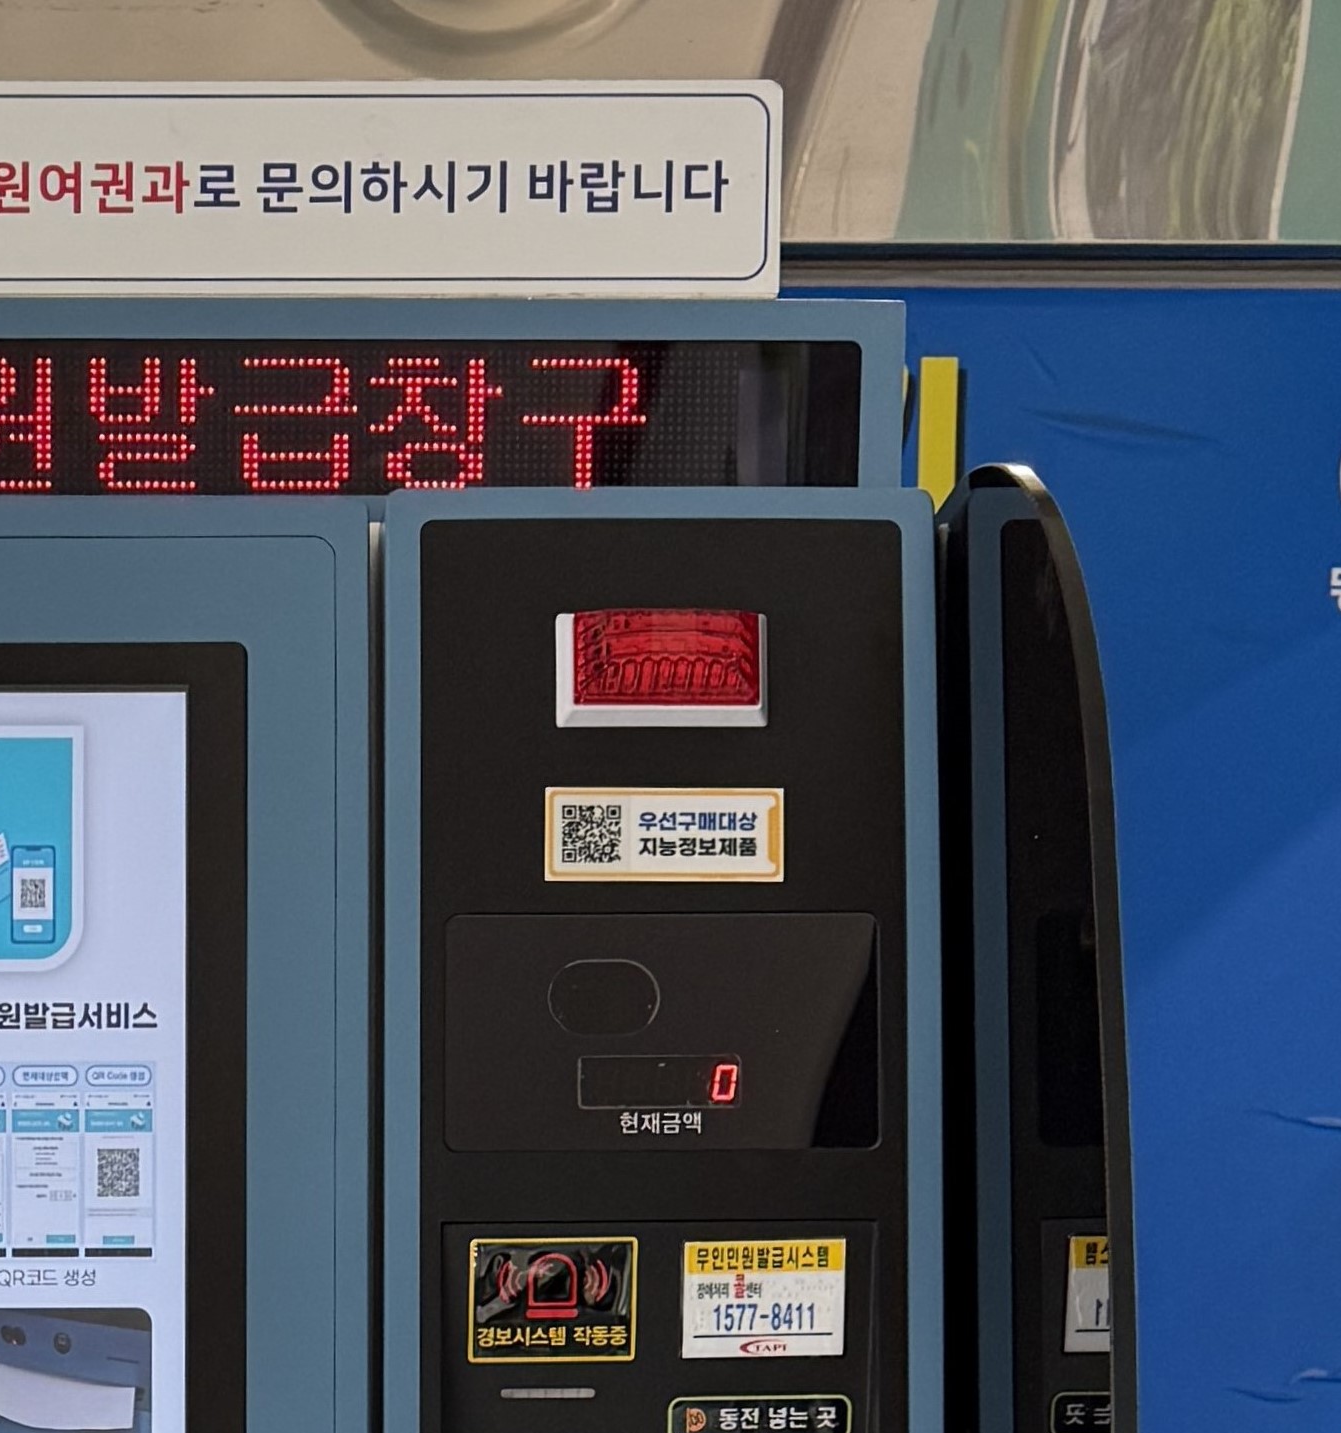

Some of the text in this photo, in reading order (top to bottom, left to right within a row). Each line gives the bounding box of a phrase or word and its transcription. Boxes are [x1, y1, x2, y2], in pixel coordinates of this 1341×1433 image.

[257, 160, 509, 213] 문의하시기
[528, 159, 730, 213] 바랍니다
[638, 811, 757, 832] 우선구매대상
[638, 837, 757, 857] 지능정보제품
[710, 1063, 738, 1101] 0
[619, 1112, 702, 1134] 현재금액
[696, 1245, 830, 1271] 무인민원발급시스템
[63, 1269, 96, 1286] 생성
[713, 1303, 815, 1332] 1577-8411
[477, 1325, 628, 1347] 경보시스템 작동중
[718, 1406, 838, 1431] 동전 넣는 곳
